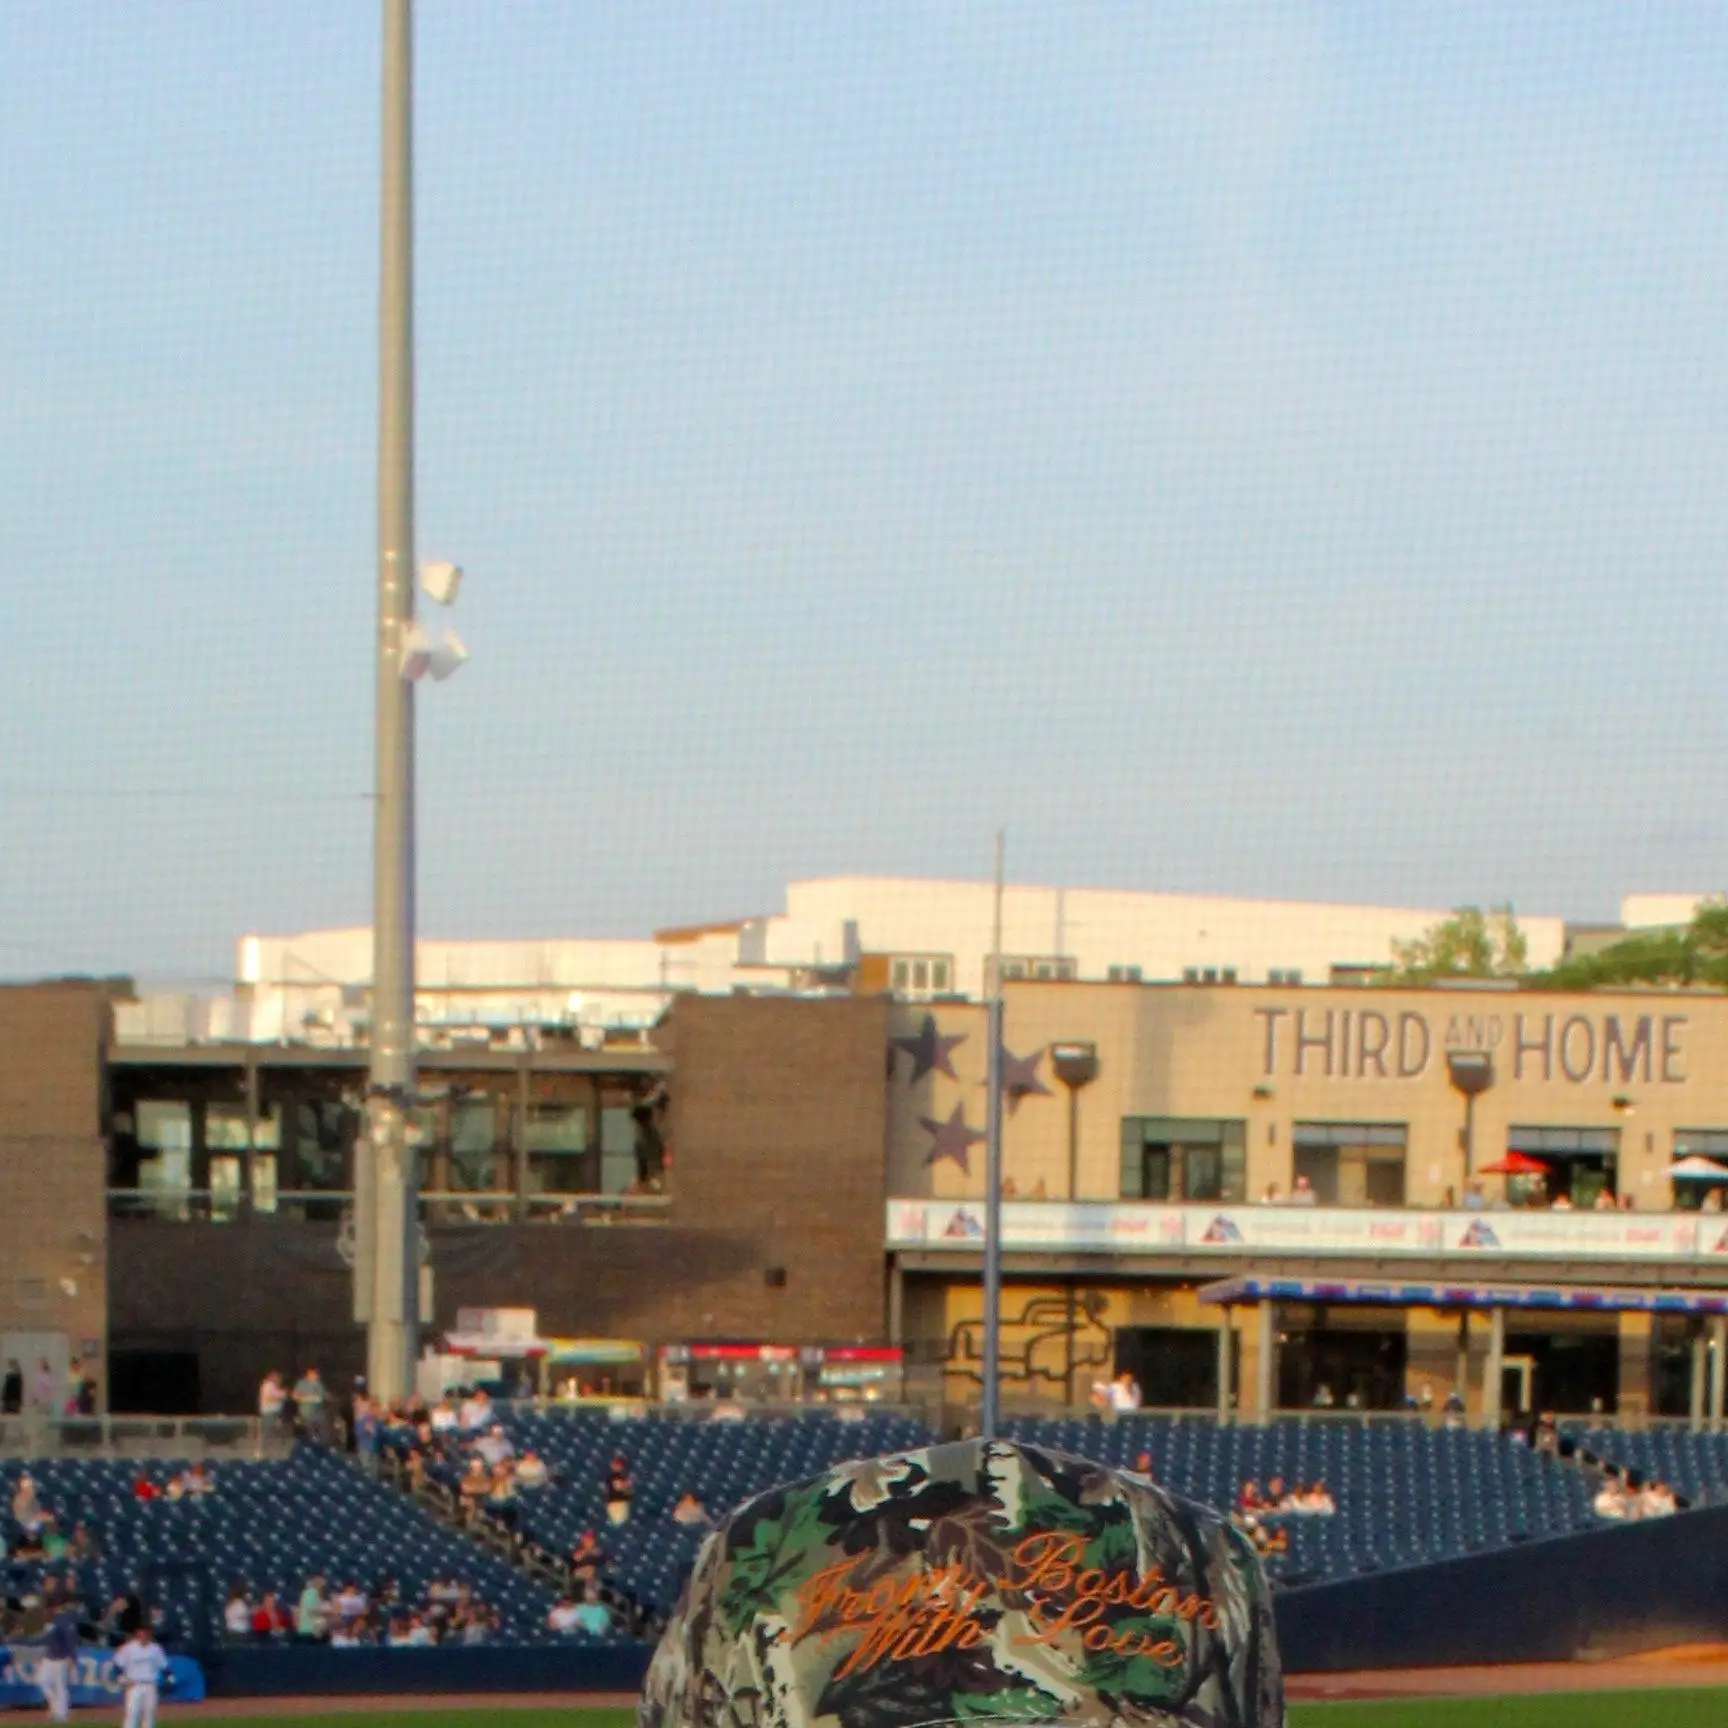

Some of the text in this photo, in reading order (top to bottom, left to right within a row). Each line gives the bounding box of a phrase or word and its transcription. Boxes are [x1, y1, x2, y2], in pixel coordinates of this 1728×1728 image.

[1253, 1006, 1689, 1083] THIRD AND HOME
[780, 1530, 1221, 1648] From Boston
[817, 1597, 1184, 1682] With Love
